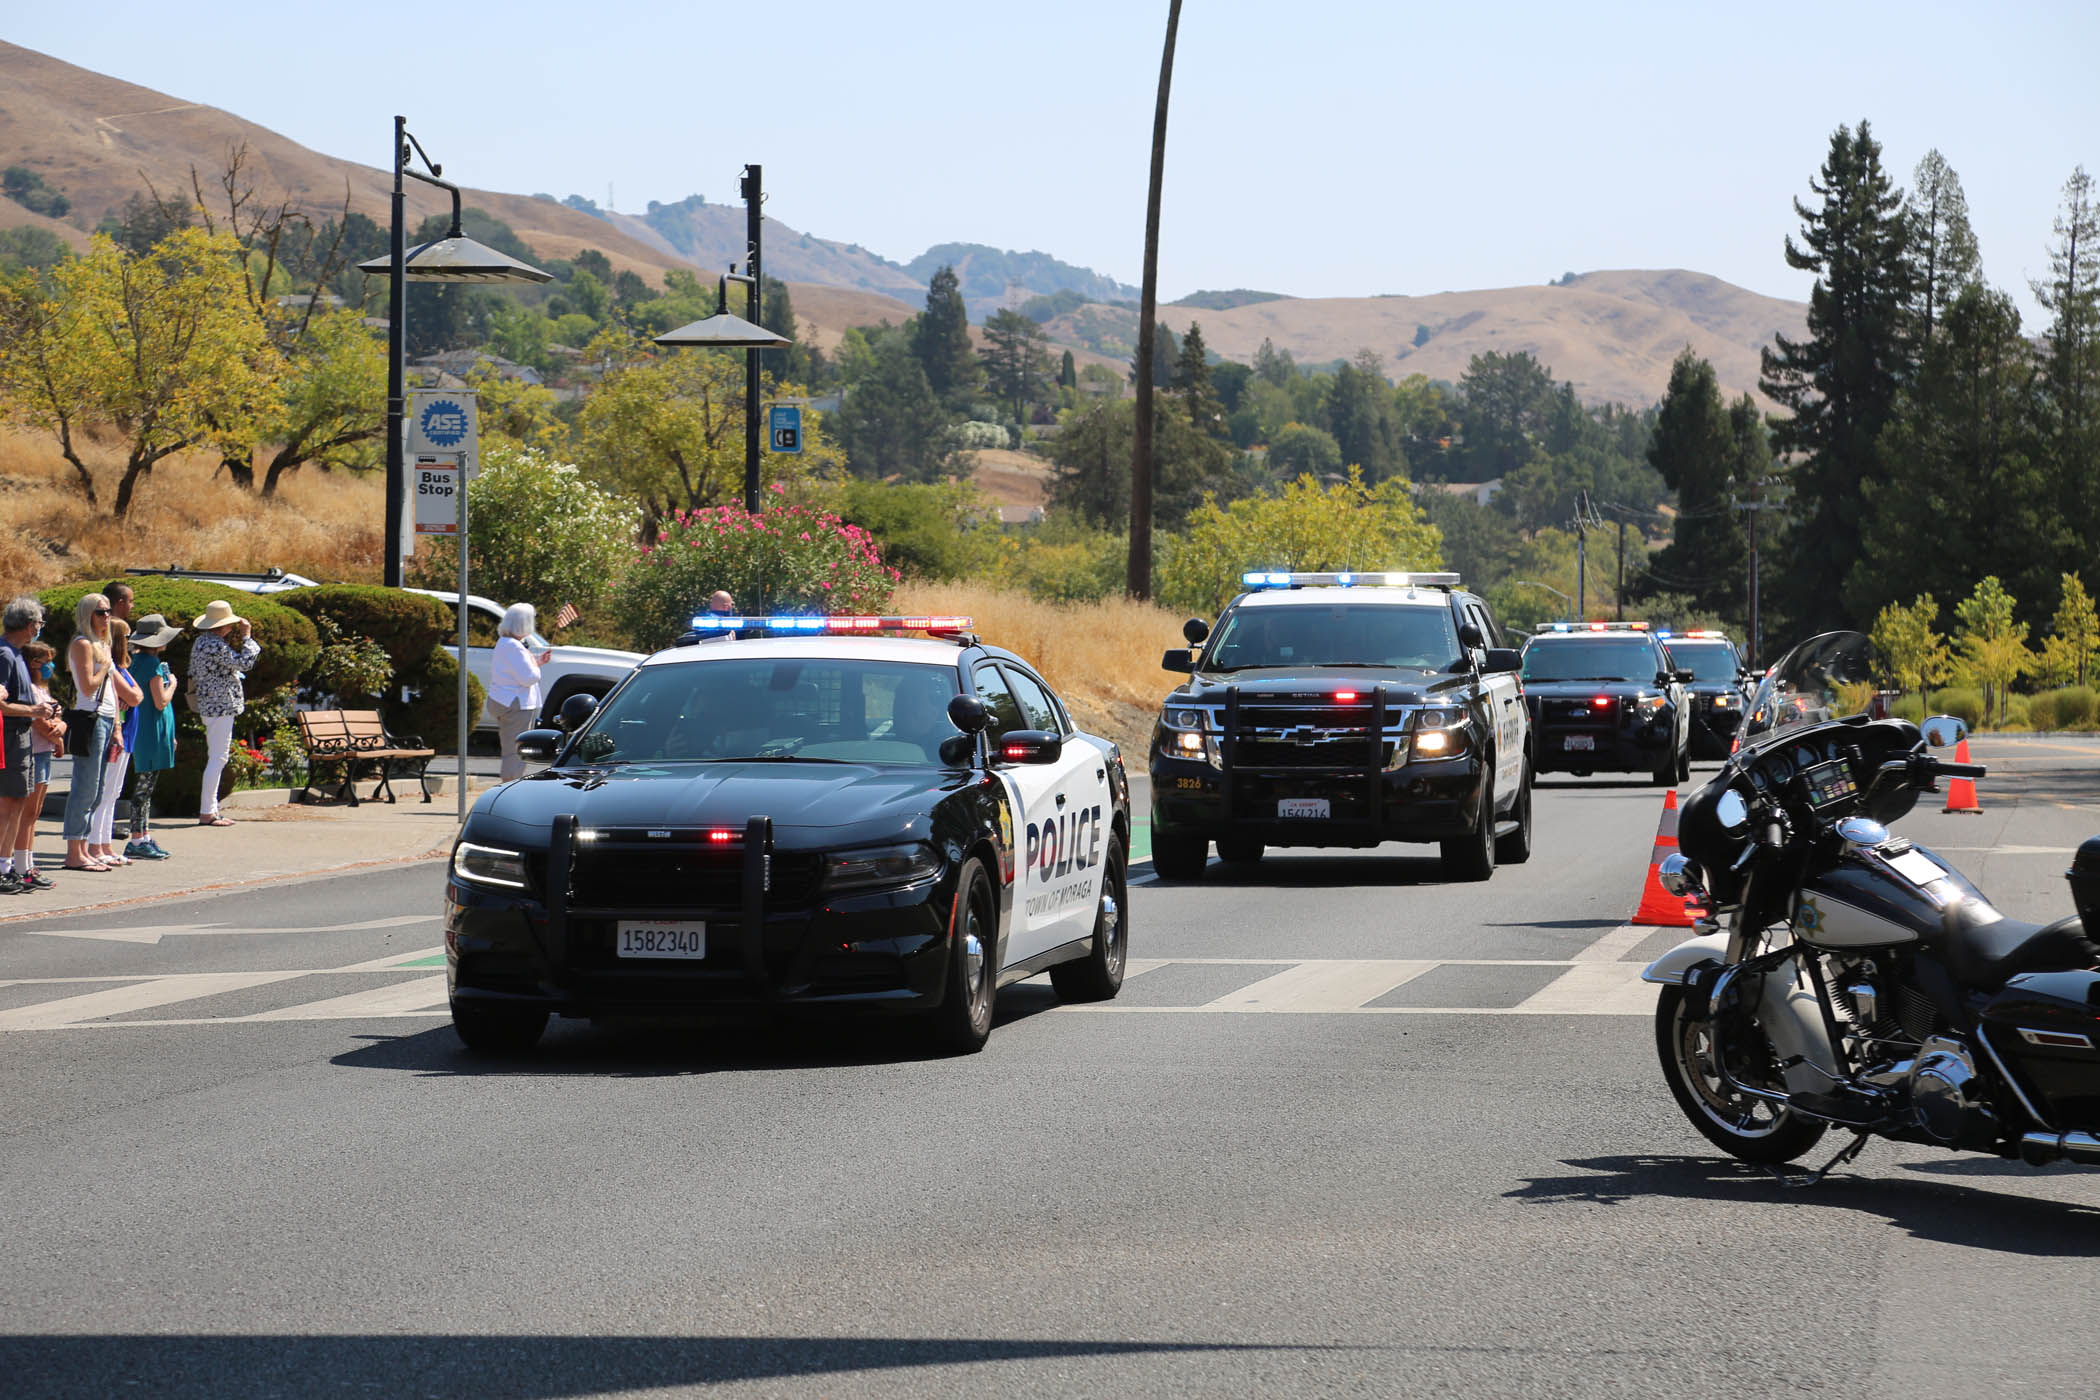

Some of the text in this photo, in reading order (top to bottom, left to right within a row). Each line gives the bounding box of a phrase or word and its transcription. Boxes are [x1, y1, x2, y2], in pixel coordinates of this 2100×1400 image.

[427, 414, 461, 429] ASE
[422, 472, 450, 483] Bus
[418, 484, 453, 497] Stop
[1176, 777, 1200, 789] 3826
[1026, 805, 1100, 888] POLICE
[1025, 879, 1092, 917] TOWN OF MORAGA
[623, 929, 699, 952] 1582340
